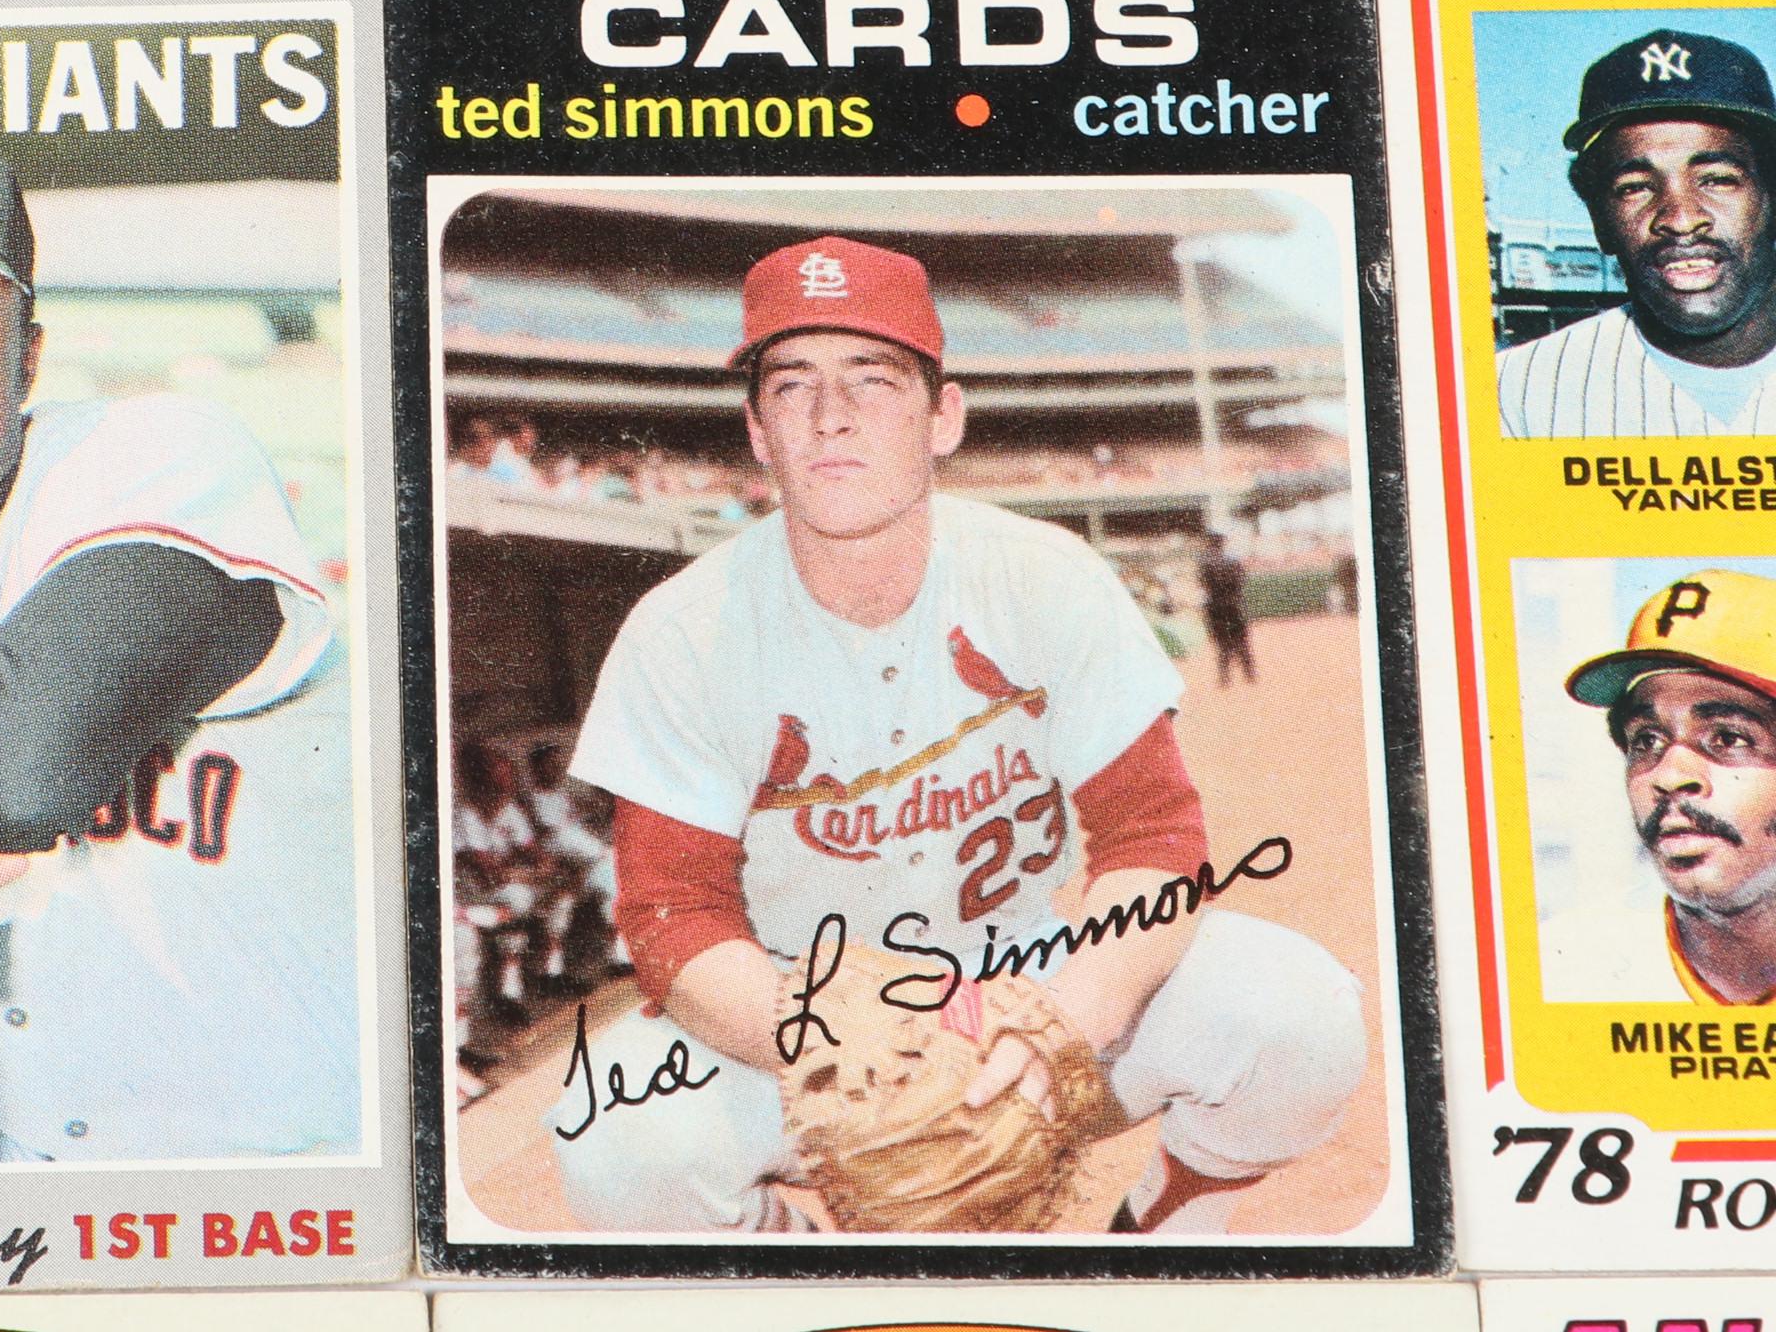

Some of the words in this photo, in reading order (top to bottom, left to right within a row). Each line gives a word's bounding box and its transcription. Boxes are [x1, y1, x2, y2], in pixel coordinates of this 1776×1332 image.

[1640, 42, 1692, 83] NY
[437, 84, 542, 139] ted
[565, 83, 874, 139] simmons
[1073, 79, 1331, 137] catcher
[1563, 455, 1673, 488] DELL
[1612, 488, 1776, 512] YANKEE
[1656, 581, 1711, 638] P
[793, 744, 1042, 863] Cardinals
[956, 777, 1067, 924] 23
[555, 1004, 722, 1141] Ted
[880, 835, 1293, 1012] Simmons
[1610, 1022, 1723, 1054] MIKE
[1492, 1125, 1635, 1206] '78
[72, 1212, 177, 1261] 1ST
[203, 1208, 356, 1258] BASE
